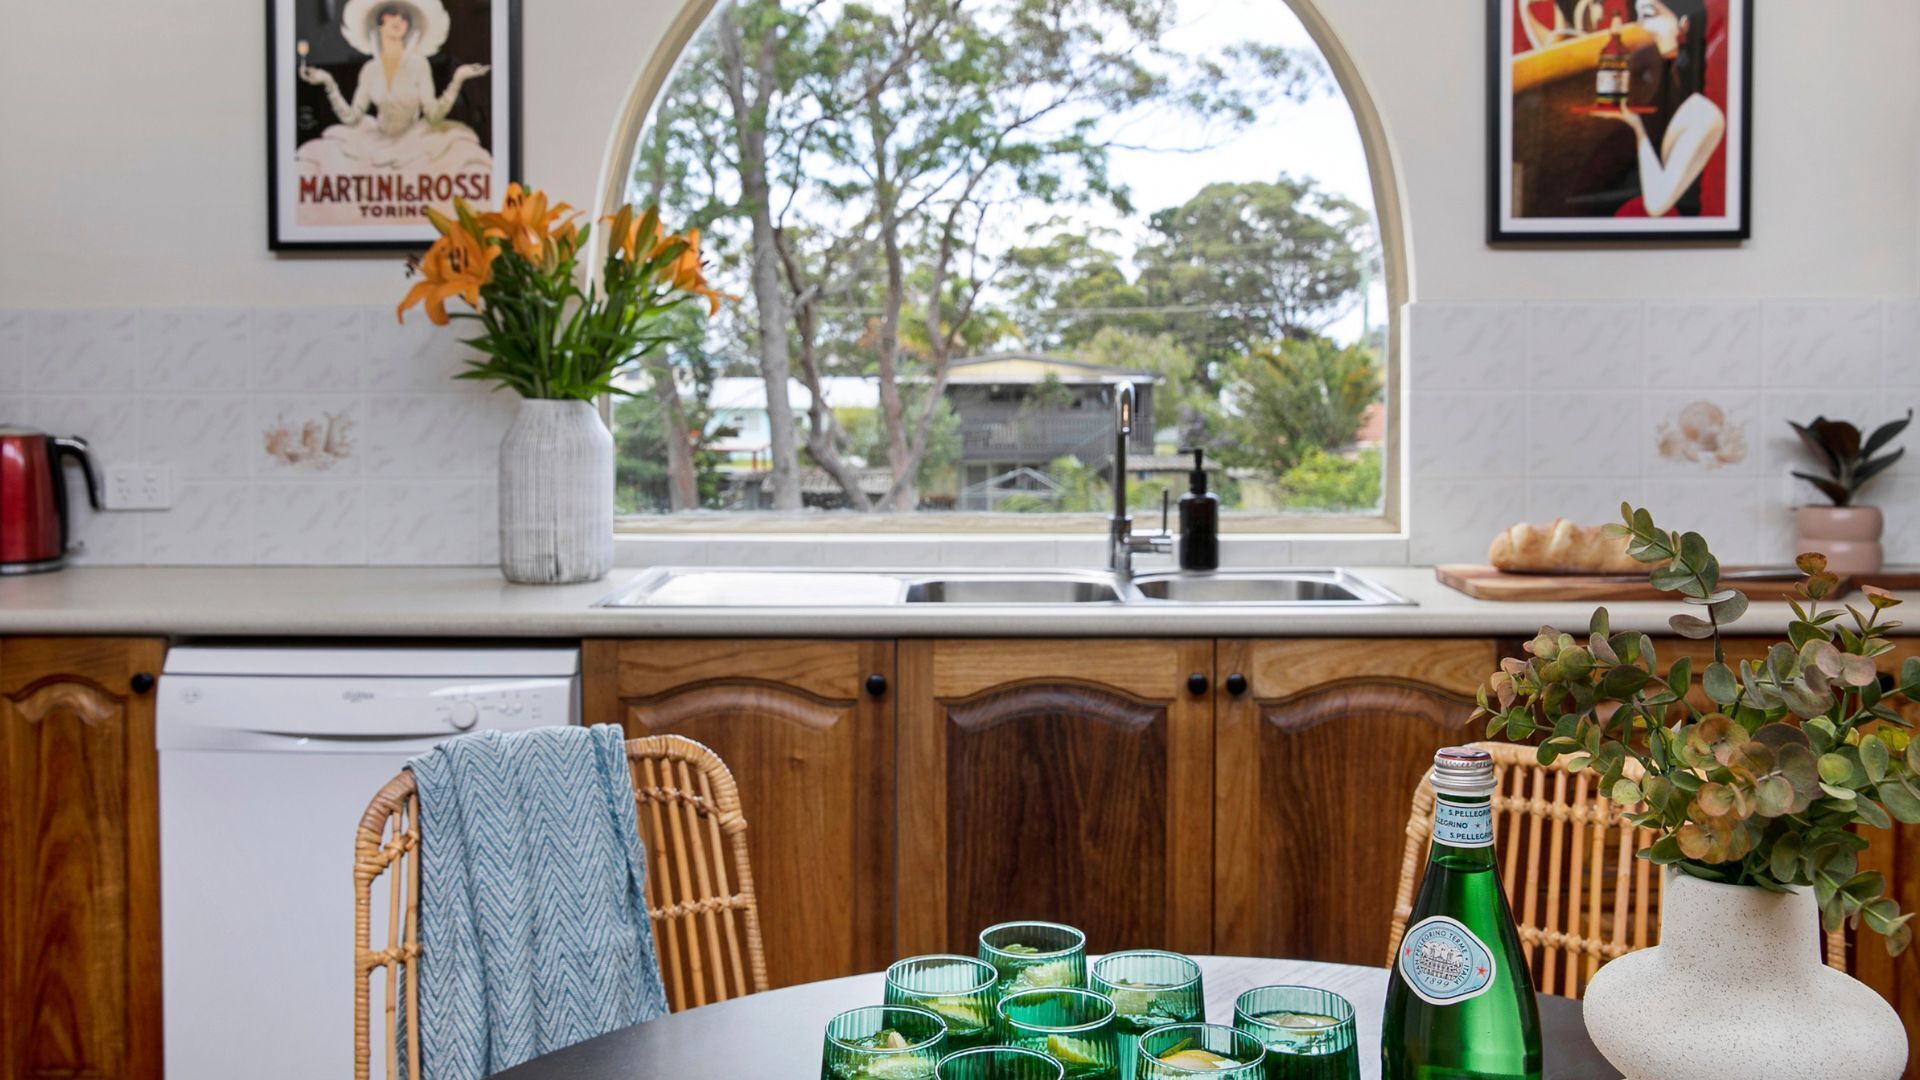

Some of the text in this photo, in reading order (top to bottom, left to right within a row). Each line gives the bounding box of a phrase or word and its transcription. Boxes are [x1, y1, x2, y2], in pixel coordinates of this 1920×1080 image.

[359, 205, 430, 218] TORINO
[1415, 930, 1446, 956] PELLEGRINO
[1449, 933, 1468, 953] TERME
[1424, 976, 1449, 987] 1899
[1454, 965, 1470, 985] ITALIA
